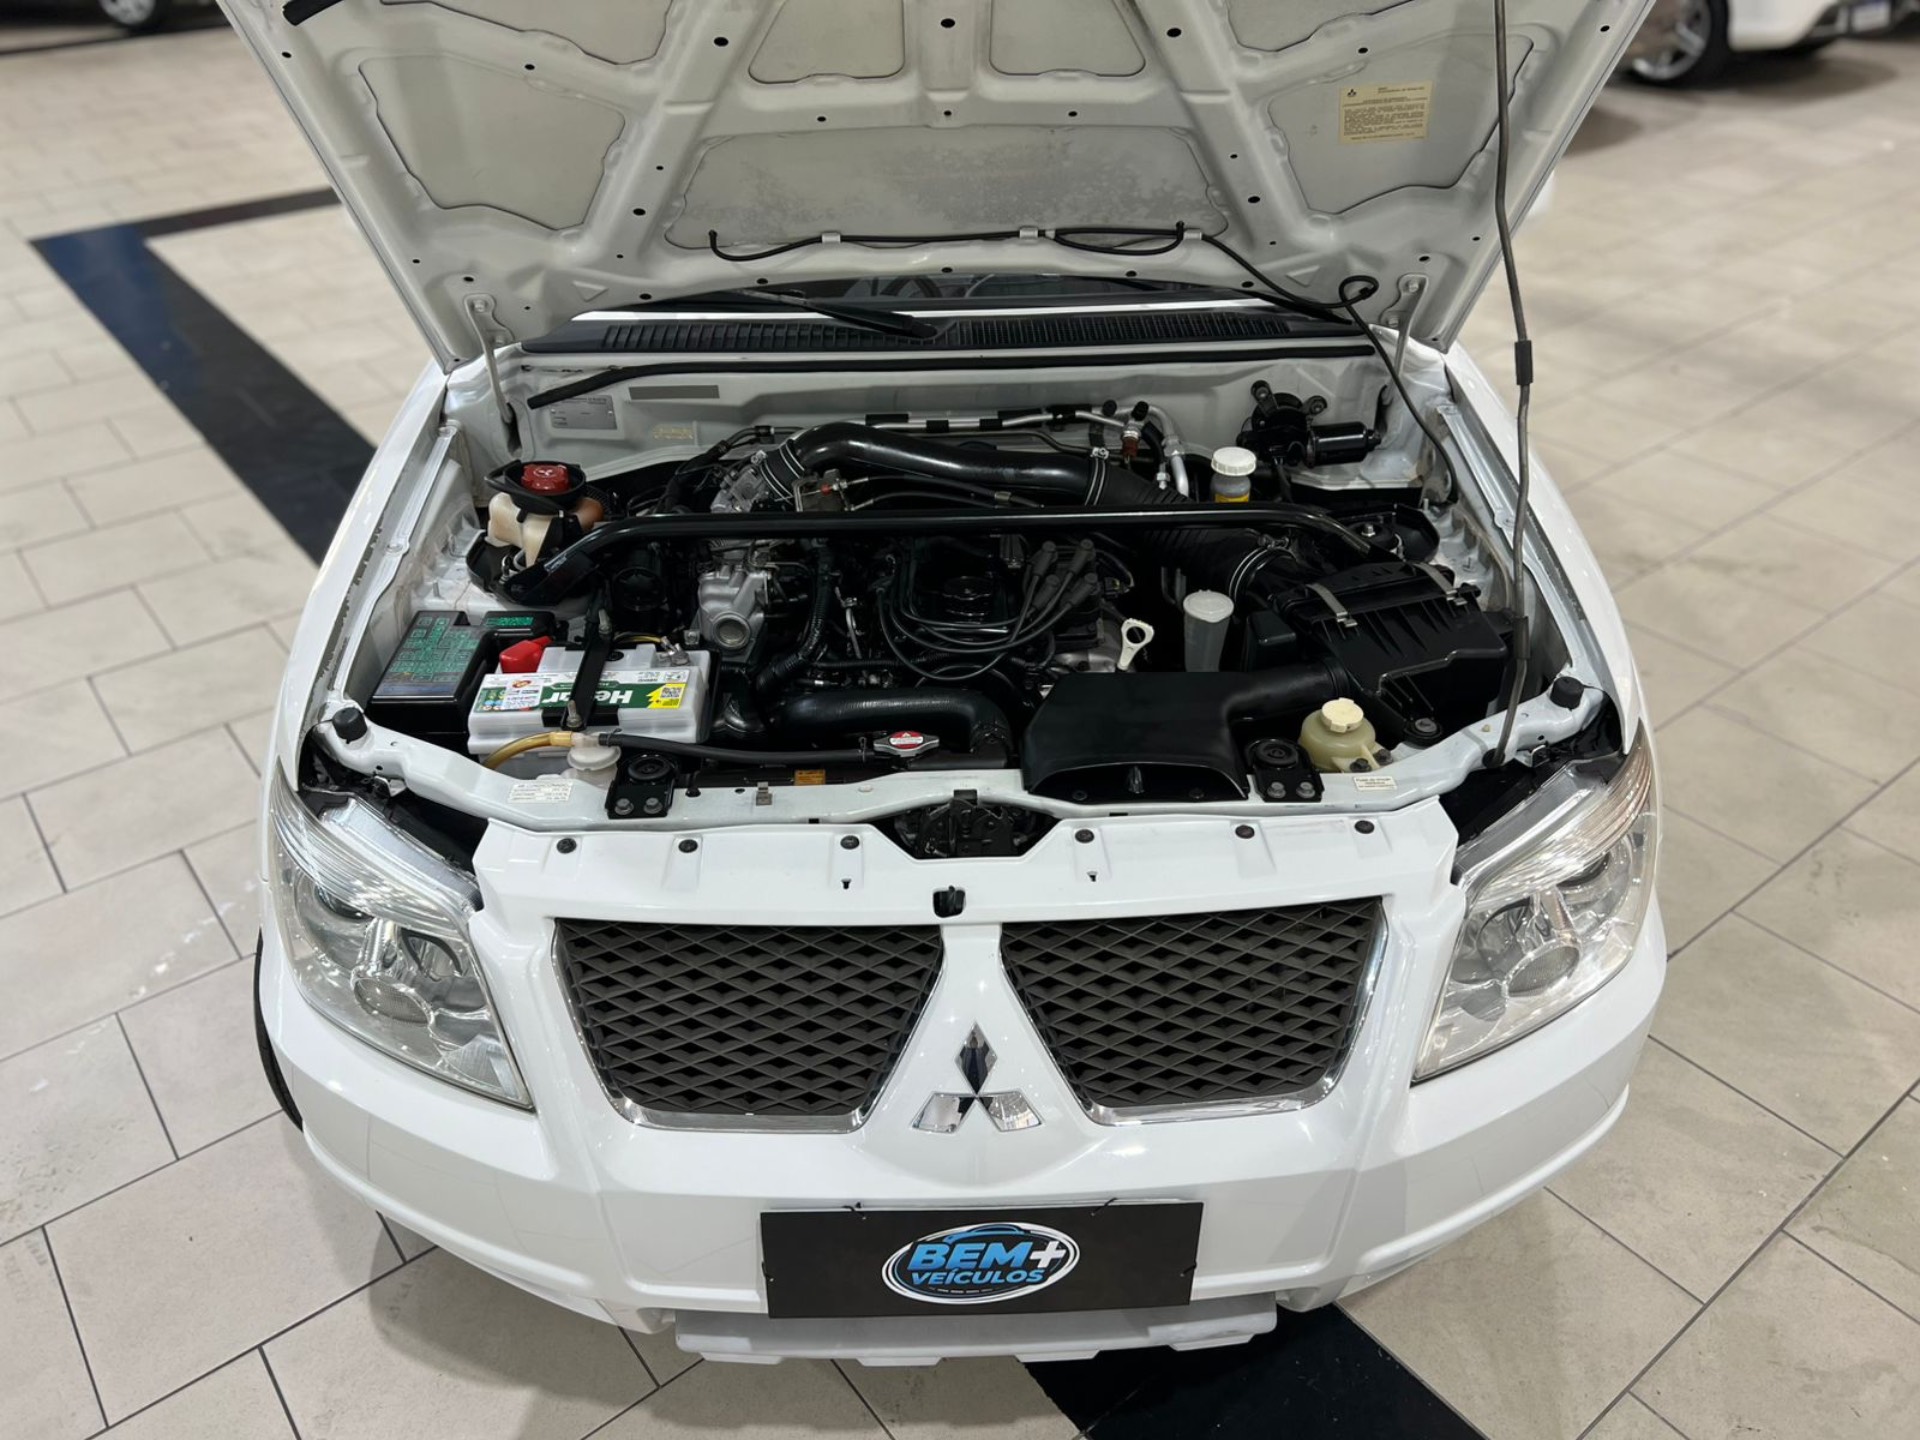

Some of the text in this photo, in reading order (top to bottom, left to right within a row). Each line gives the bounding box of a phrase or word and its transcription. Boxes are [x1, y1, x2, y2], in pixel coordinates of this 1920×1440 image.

[542, 690, 633, 704] Hear
[907, 1241, 1066, 1270] BEM+
[911, 1268, 1045, 1285] VEÍCULOS
